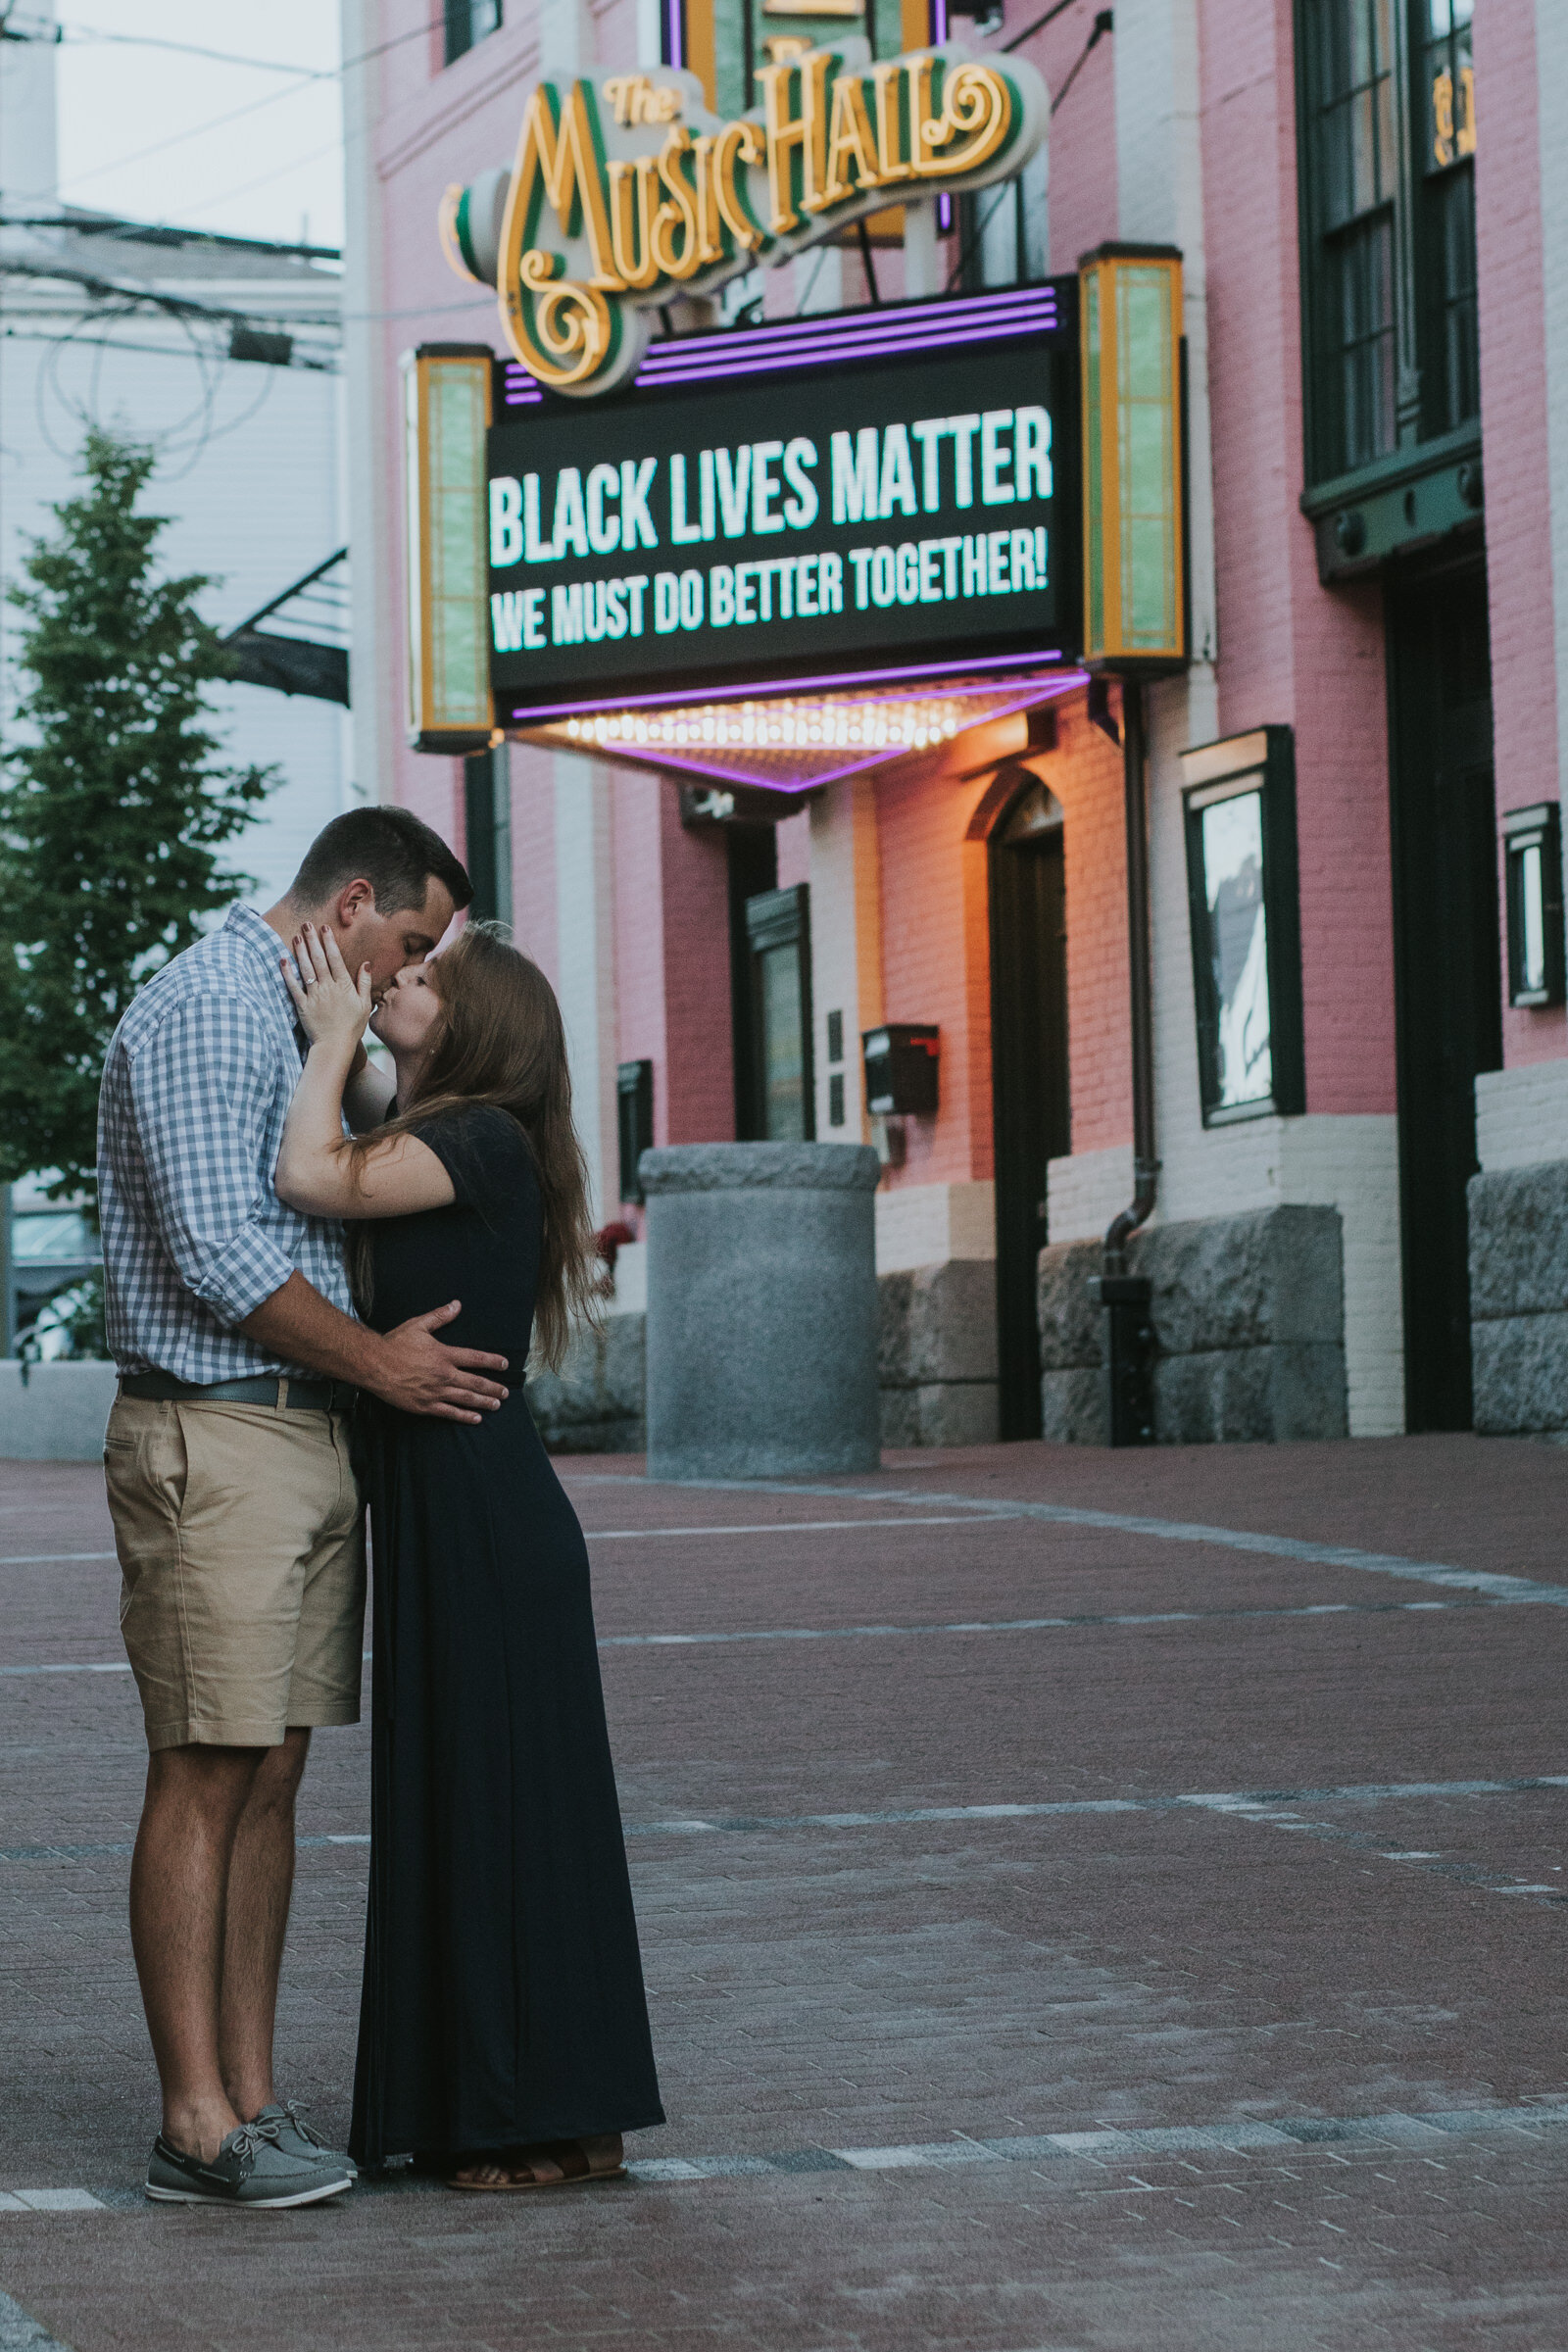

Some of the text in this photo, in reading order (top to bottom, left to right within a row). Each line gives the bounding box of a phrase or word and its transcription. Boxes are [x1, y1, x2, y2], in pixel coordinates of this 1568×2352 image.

[602, 74, 684, 125] The
[754, 52, 1012, 235] HALL
[489, 405, 1054, 568] BLACK LIVES MATTER
[490, 525, 1050, 653] WE MUST DO BETTER TOGETHER!
